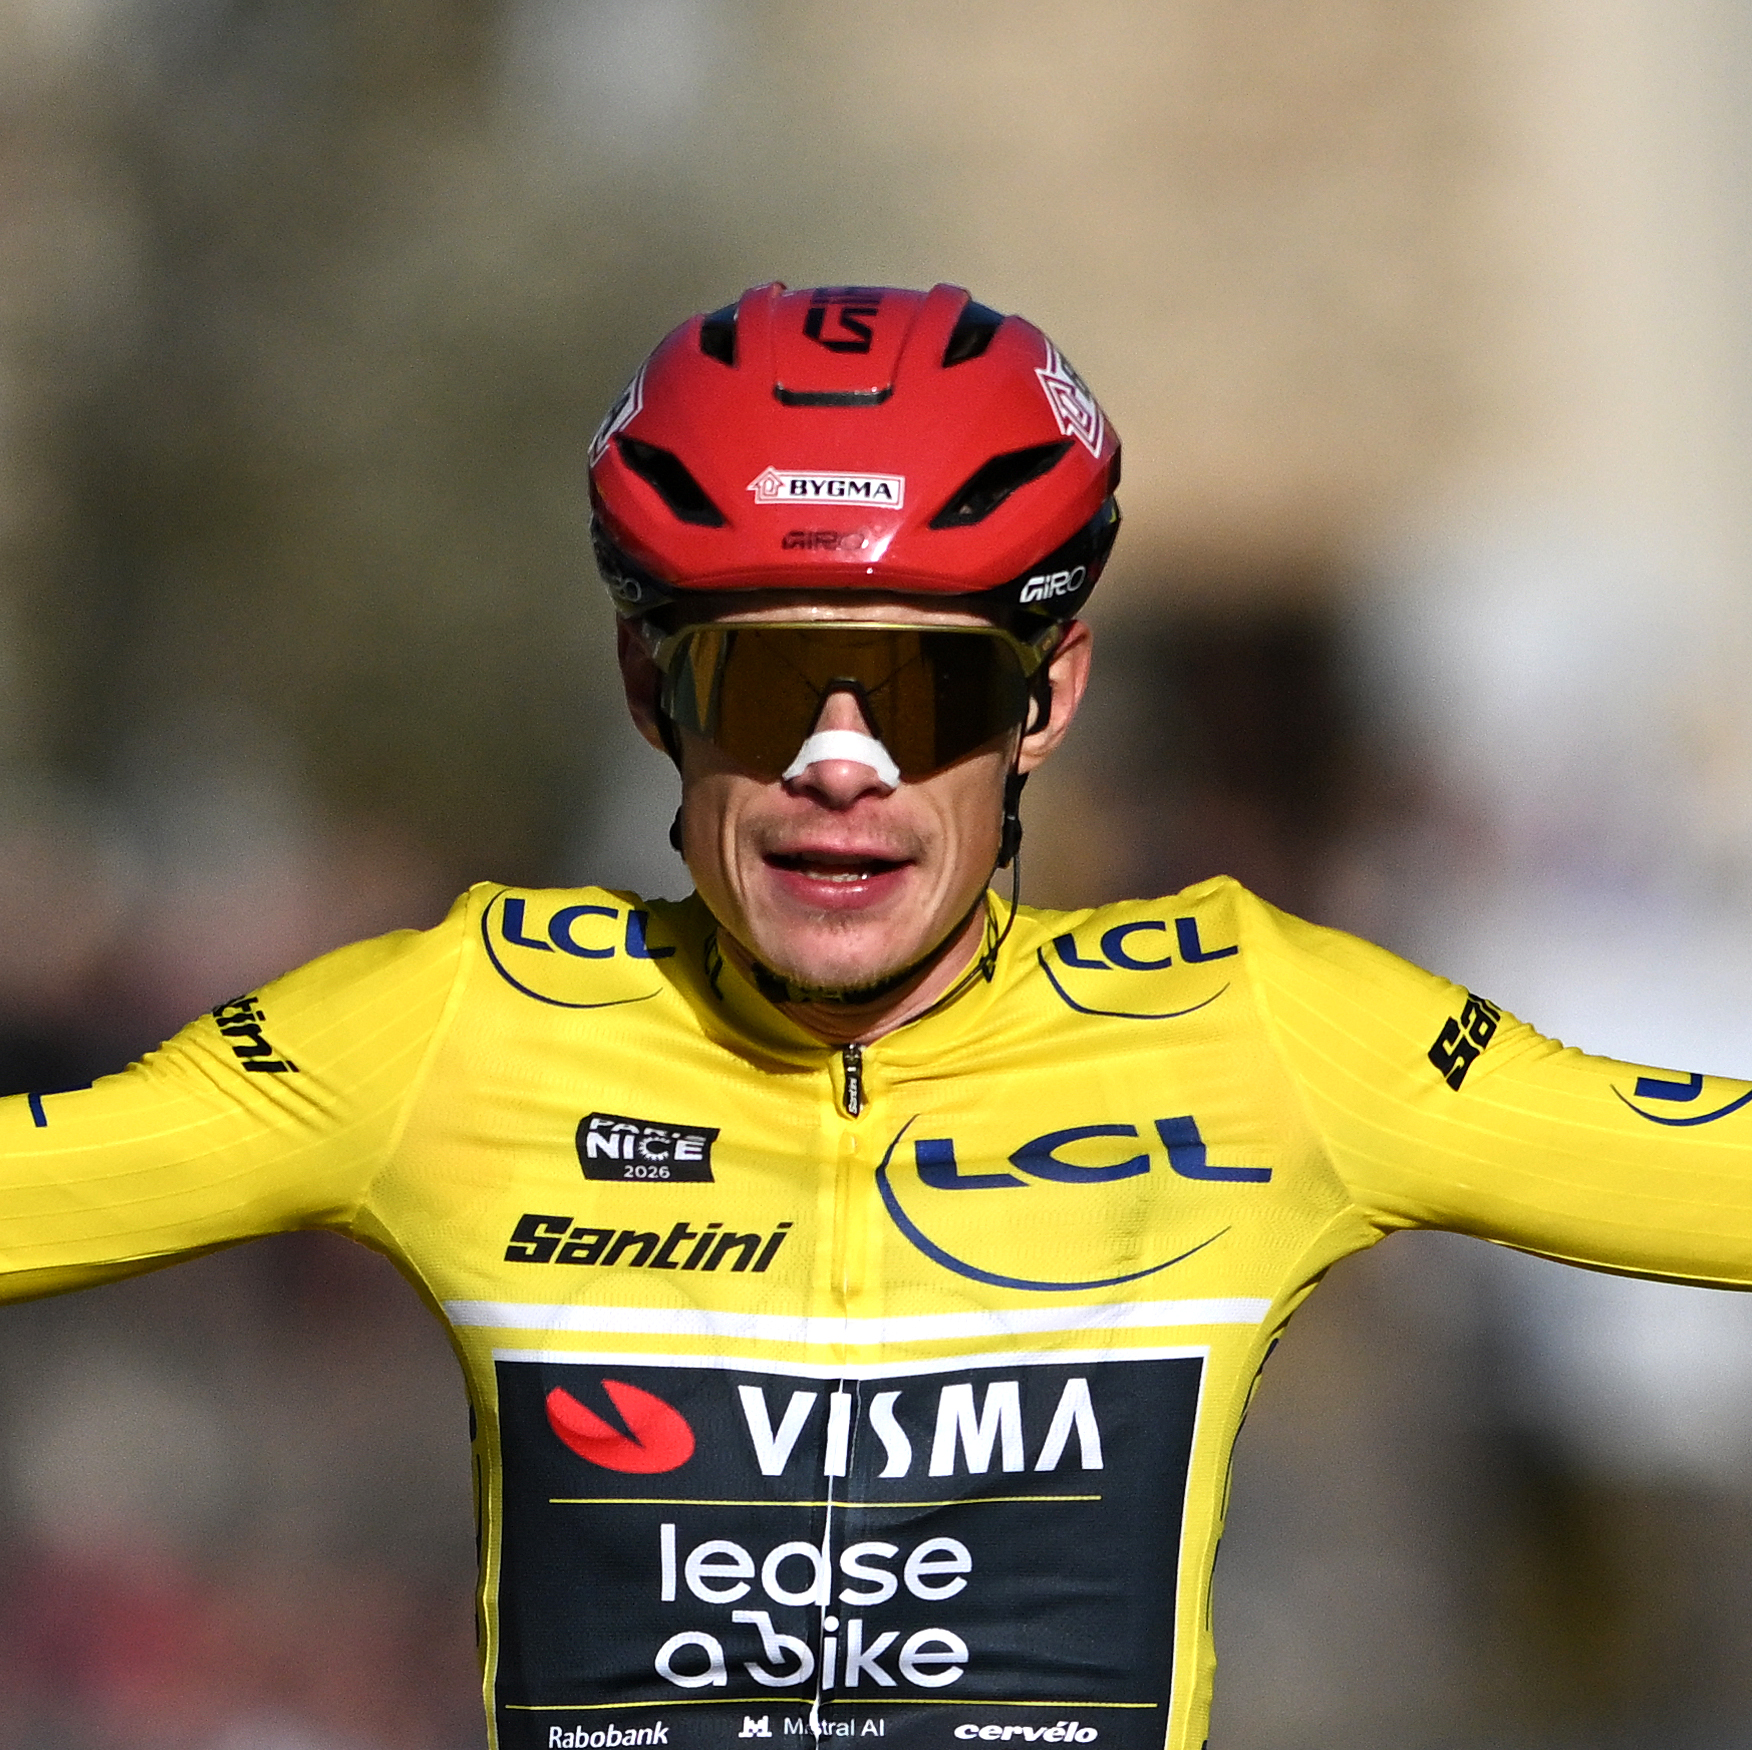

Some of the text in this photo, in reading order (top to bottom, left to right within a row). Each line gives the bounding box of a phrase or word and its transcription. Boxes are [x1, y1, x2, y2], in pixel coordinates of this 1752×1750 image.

[789, 479, 893, 500] BYGMA
[1019, 565, 1087, 603] GIRO
[502, 897, 676, 960] LCL
[1052, 916, 1239, 971] LCL
[586, 1131, 705, 1161] NICE
[913, 1115, 1273, 1191] LCL
[623, 1165, 671, 1179] 2026
[504, 1213, 794, 1274] Santini
[737, 1377, 1104, 1479] VISMA
[659, 1522, 973, 1607] lease
[549, 1721, 669, 1749] Rabobank
[860, 1718, 885, 1737] AI
[954, 1720, 1099, 1743] cervélo
